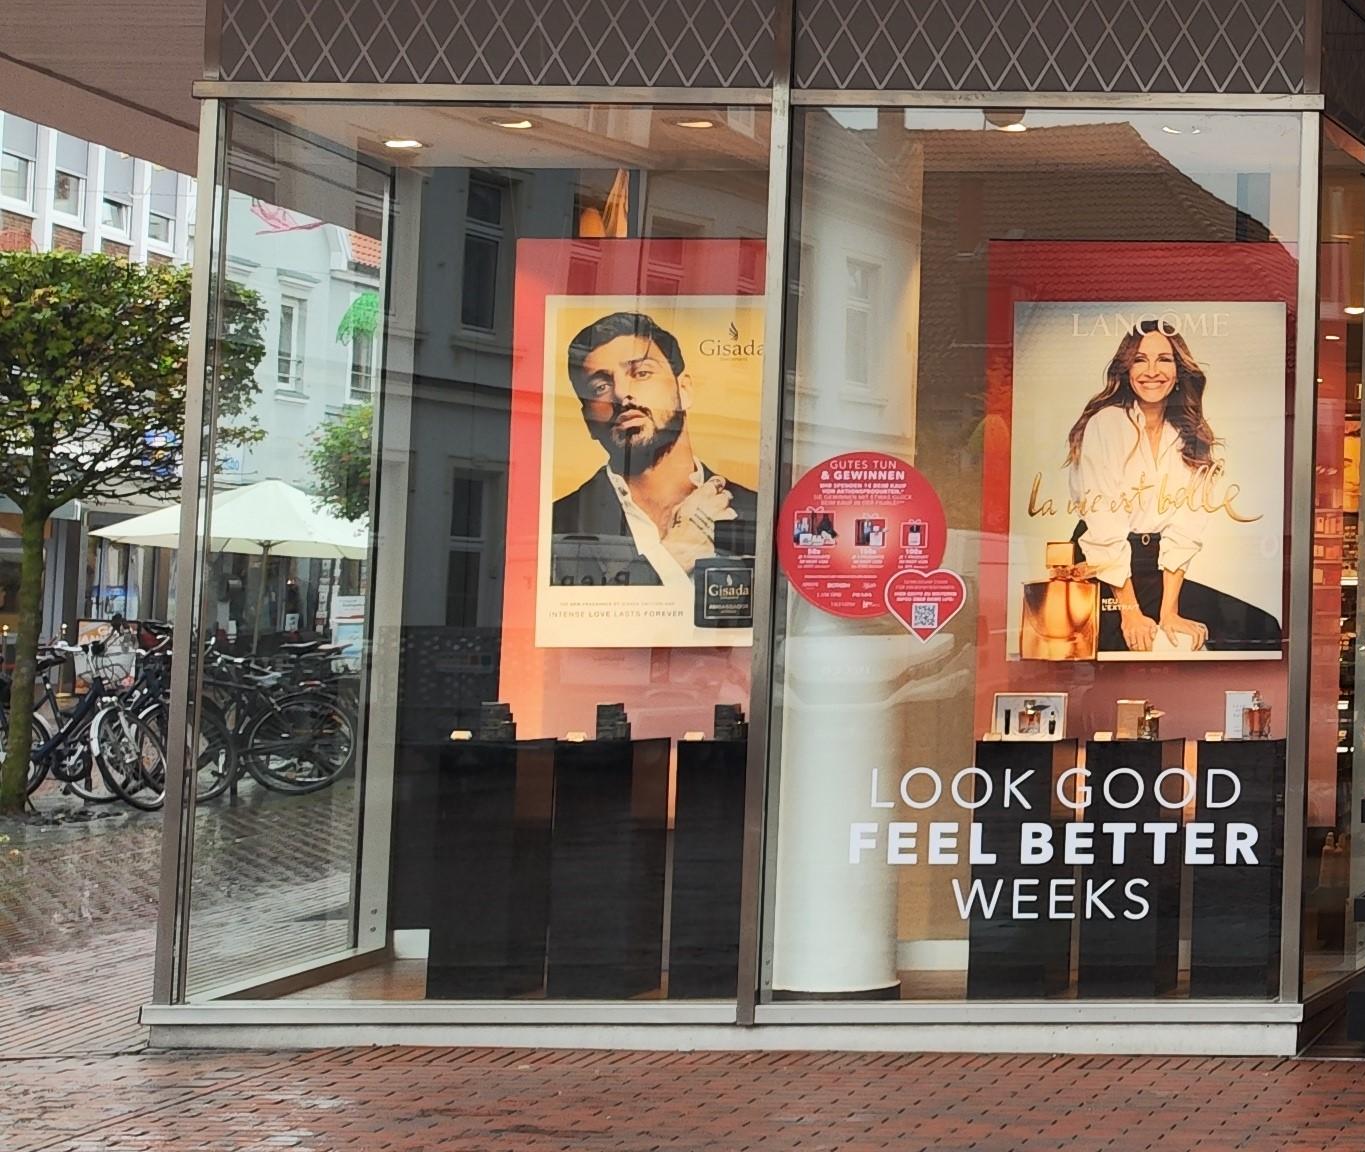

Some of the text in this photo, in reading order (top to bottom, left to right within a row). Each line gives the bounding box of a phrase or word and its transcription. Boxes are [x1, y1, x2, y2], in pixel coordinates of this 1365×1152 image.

[1072, 308, 1230, 338] LANCÔME
[820, 470, 905, 480] & GEWINNEN
[830, 459, 897, 470] GUTES TUN
[1028, 458, 1264, 523] la vie est belle
[708, 584, 750, 597] Gisada
[870, 766, 1242, 810] LOOK GOOD
[848, 822, 1260, 865] FEEL BETTER
[951, 878, 1151, 921] WEEKS
